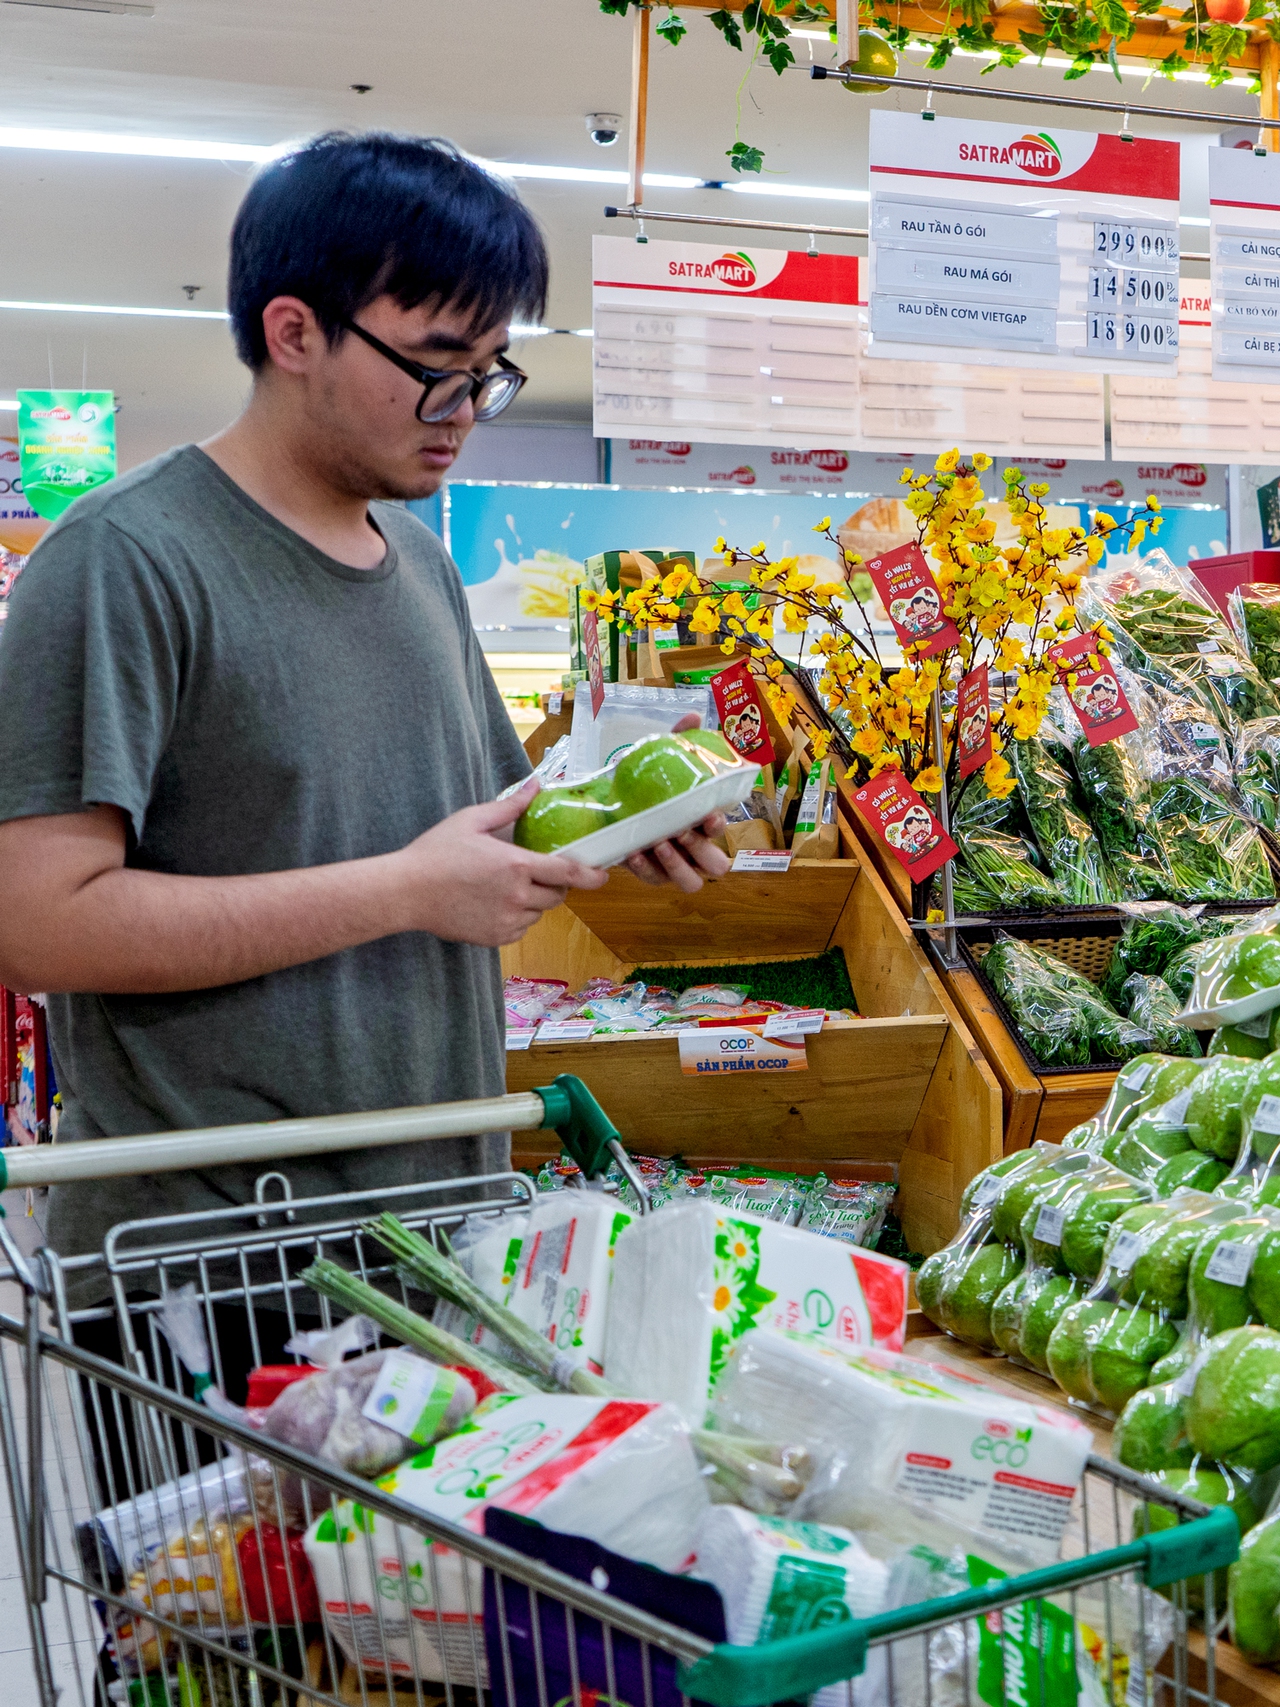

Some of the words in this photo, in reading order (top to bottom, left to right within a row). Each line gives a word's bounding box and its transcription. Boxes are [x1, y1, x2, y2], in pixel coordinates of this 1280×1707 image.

[959, 143, 1054, 169] SATRAMART
[901, 220, 925, 233] RAU
[928, 219, 950, 235] TẦN
[954, 221, 963, 236] Ô
[965, 223, 986, 238] GÓI
[1097, 232, 1165, 257] 29900
[1242, 242, 1258, 254] CẢI
[669, 261, 752, 282] SATRAMART
[944, 265, 967, 278] RAU
[970, 265, 989, 280] MÁ
[991, 268, 1012, 283] GÓI
[1245, 273, 1261, 286] CẢI
[1092, 277, 1165, 301] 14500
[898, 303, 922, 315] RAU
[925, 302, 948, 318] DỀN
[951, 306, 979, 321] CƠM
[981, 310, 1027, 325] VIETGAP
[1092, 321, 1165, 345] 18900
[1244, 338, 1261, 350] CẢI
[1263, 340, 1276, 353] BẸ
[720, 1038, 754, 1050] OCOP
[696, 1059, 719, 1072] SẢN
[722, 1056, 756, 1071] PHẨM
[758, 1059, 789, 1070] OCOP
[971, 1434, 1029, 1468] eco
